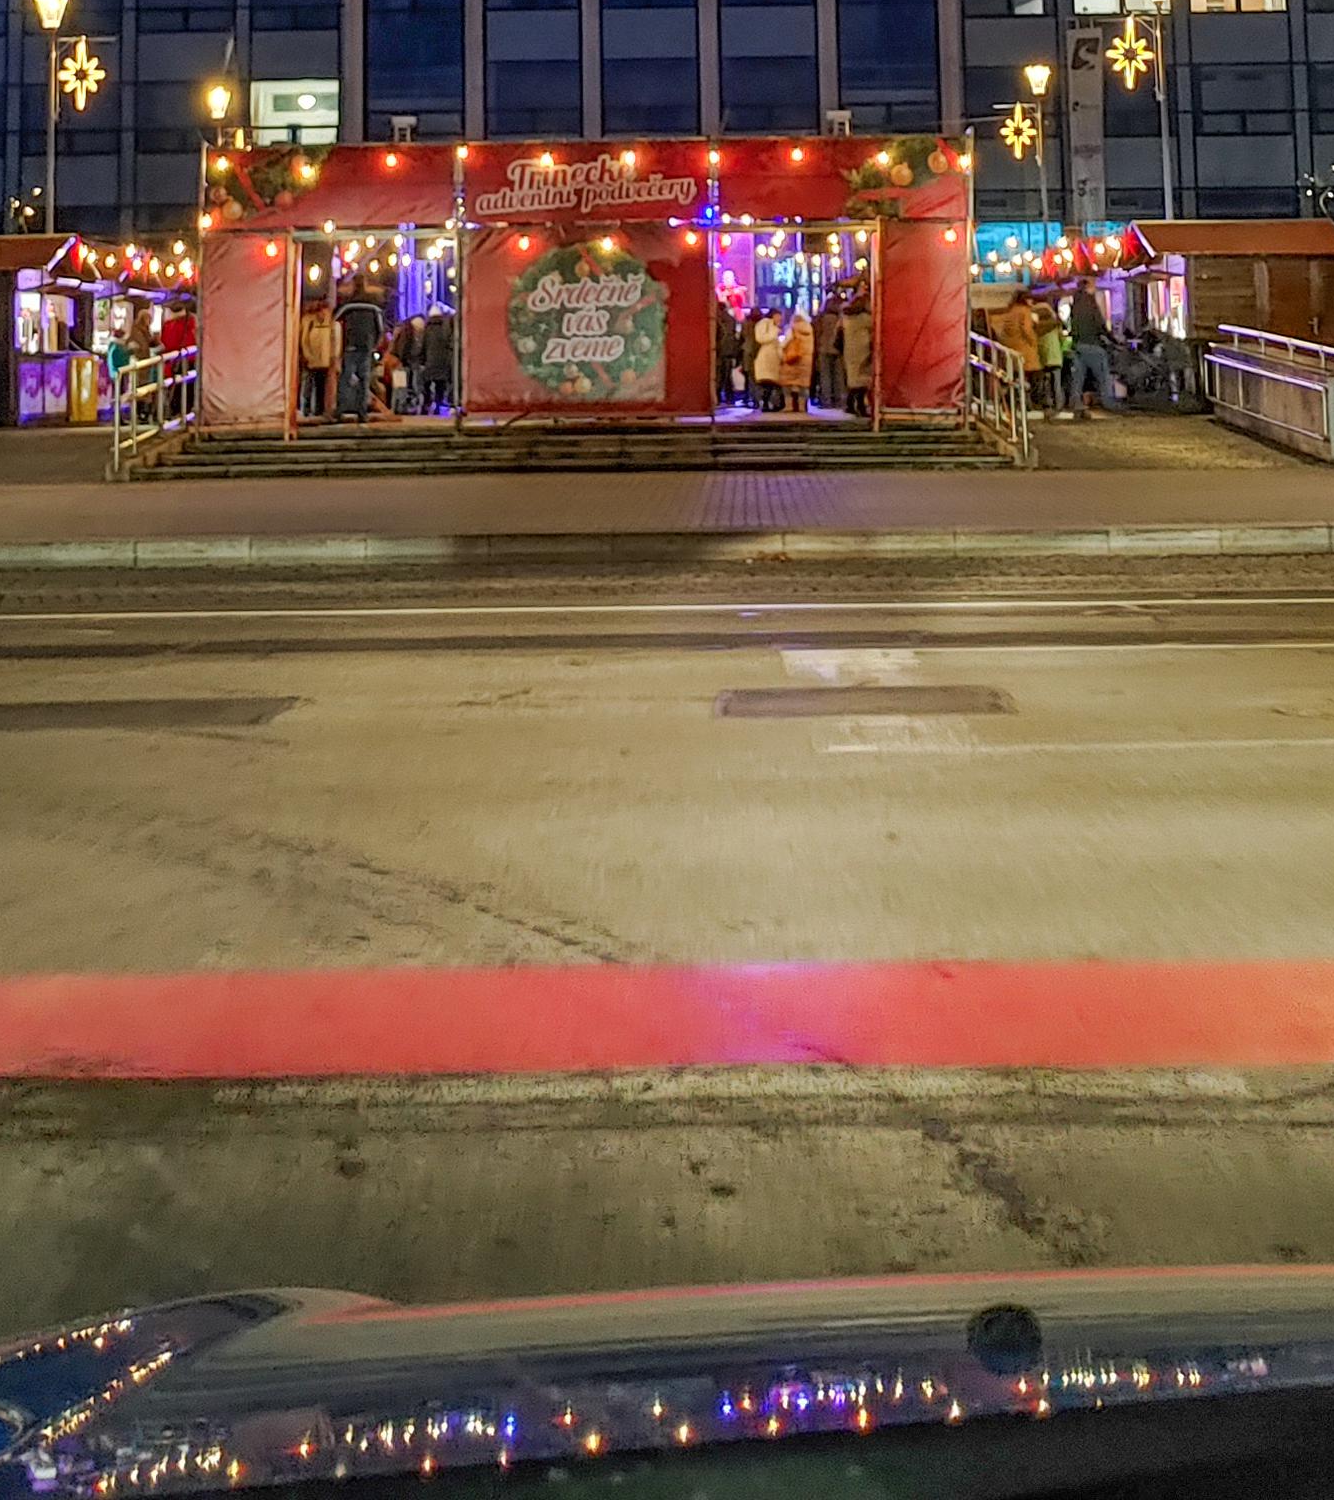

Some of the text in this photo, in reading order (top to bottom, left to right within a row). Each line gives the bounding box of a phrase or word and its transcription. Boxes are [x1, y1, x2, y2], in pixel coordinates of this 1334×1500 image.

[528, 273, 645, 312] Srdečně
[562, 305, 610, 336] vás
[542, 335, 625, 364] zveme
